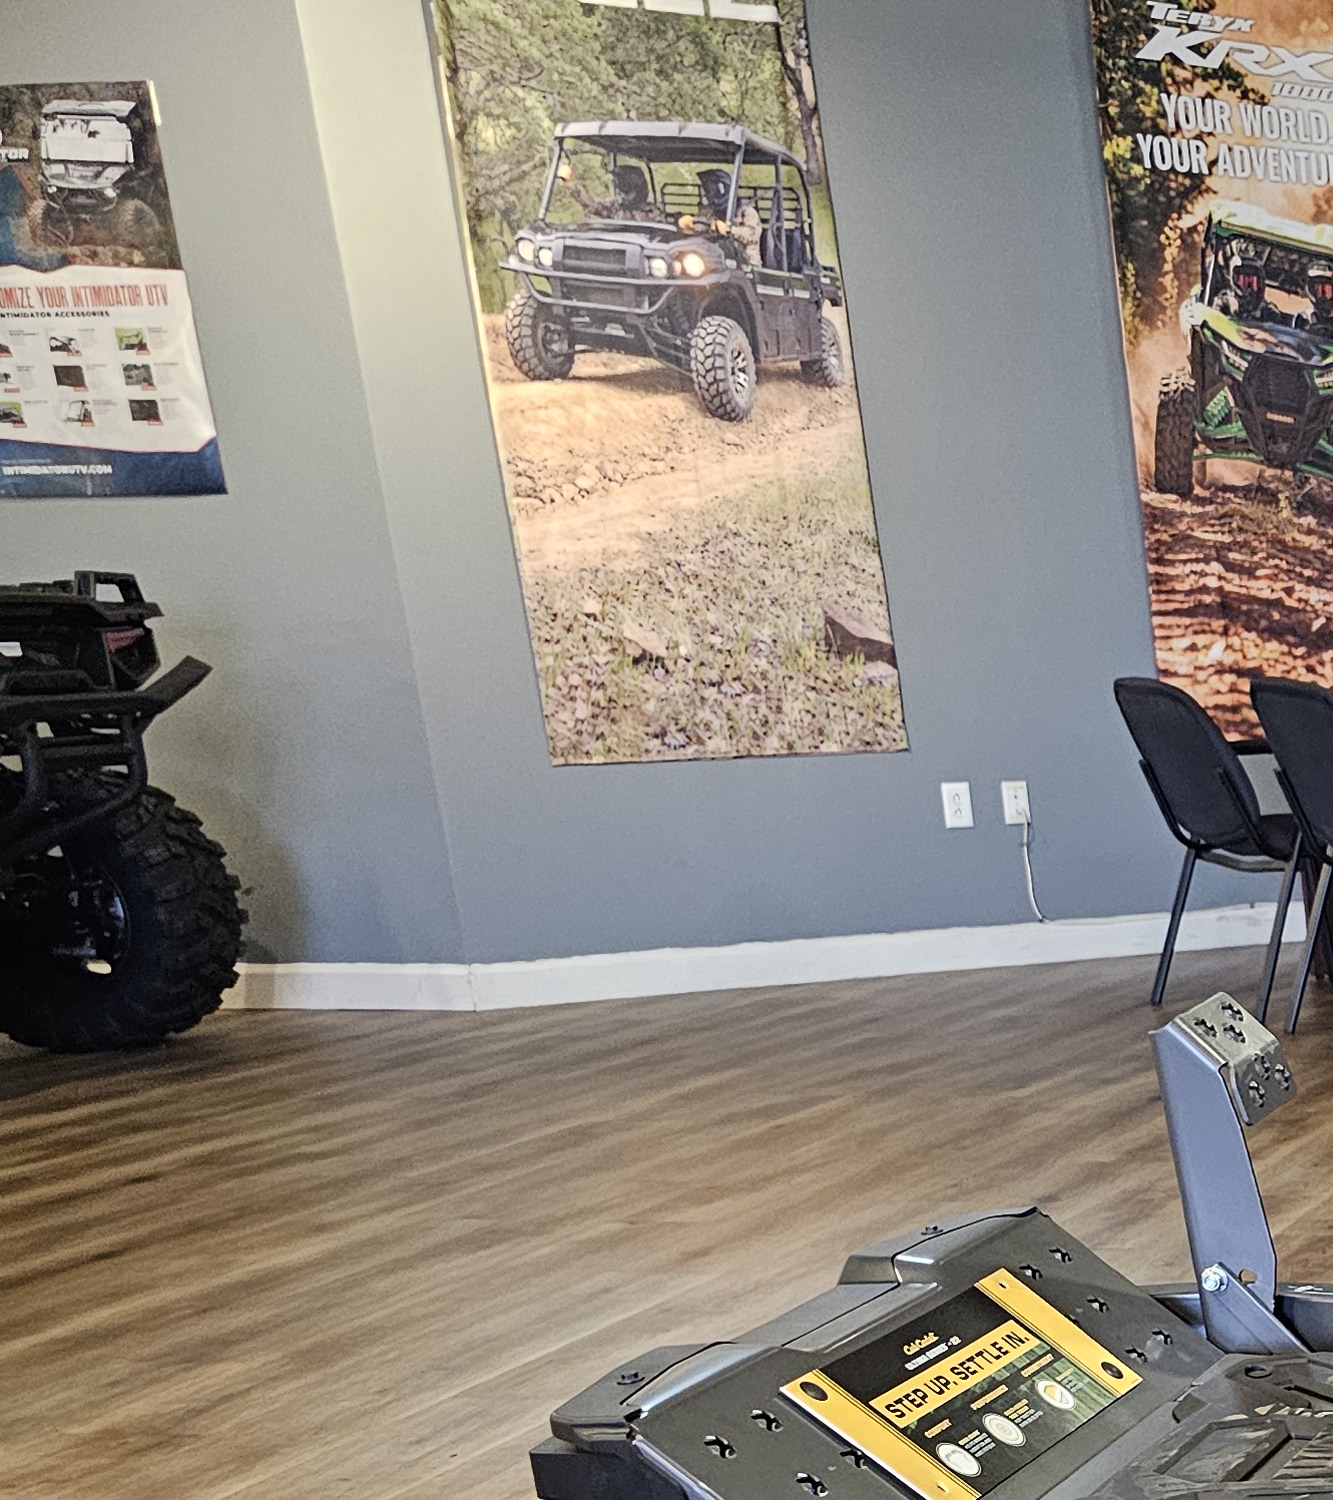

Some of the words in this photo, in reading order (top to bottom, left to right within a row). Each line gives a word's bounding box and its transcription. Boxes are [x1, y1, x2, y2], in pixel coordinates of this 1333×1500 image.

[1146, 1, 1255, 32] TERYX
[1160, 92, 1233, 135] YOUR
[1136, 132, 1210, 175] YOUR
[36, 286, 69, 309] YOUR
[70, 284, 144, 309] INTIMIDATOR
[145, 284, 168, 307] UTV
[885, 1388, 929, 1419] STEP
[924, 1375, 959, 1396] UP.
[949, 1341, 1011, 1381] SETTLE
[1001, 1331, 1031, 1350] IN.
